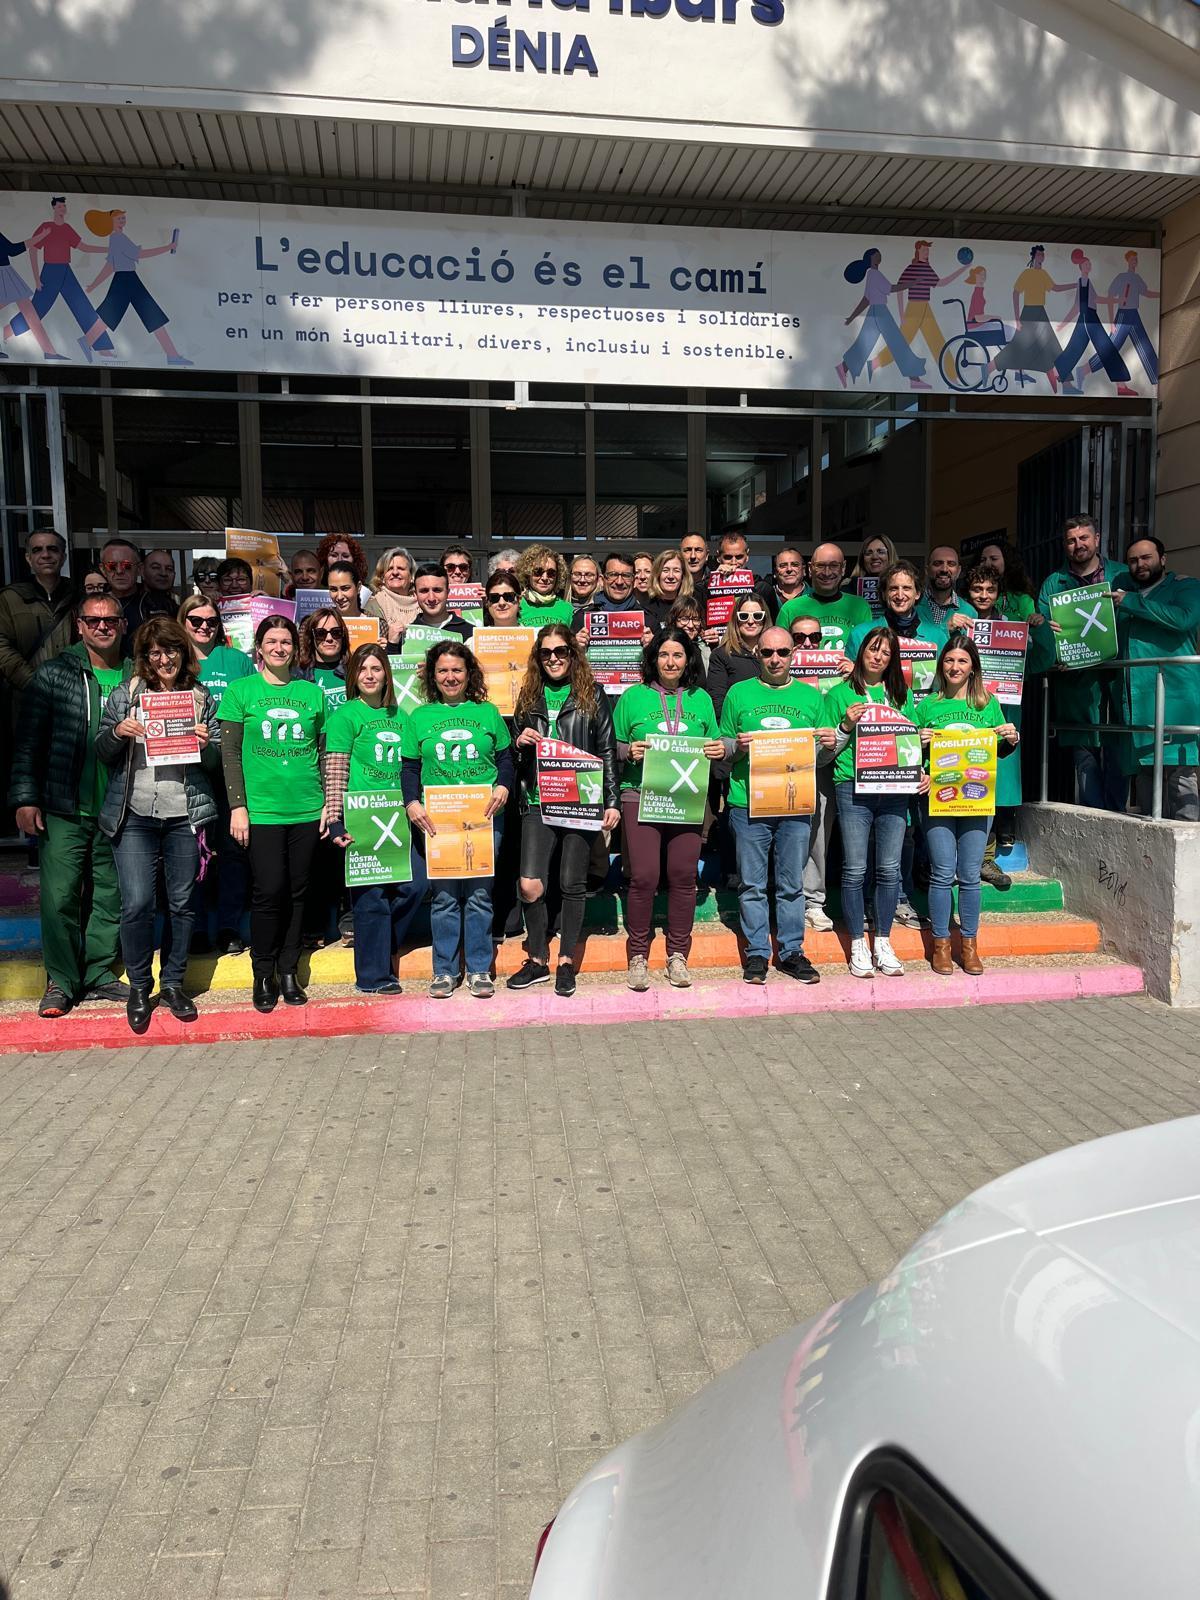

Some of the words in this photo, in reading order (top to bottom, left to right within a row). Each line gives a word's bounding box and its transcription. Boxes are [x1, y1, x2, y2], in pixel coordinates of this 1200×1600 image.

[452, 16, 598, 76] DÉNIA
[255, 236, 514, 284] L'educació
[534, 252, 582, 286] és
[603, 256, 650, 289] el
[670, 262, 767, 294] camí
[218, 291, 253, 306] per
[266, 294, 277, 305] a
[289, 292, 323, 308] fer
[335, 297, 425, 312] persones
[438, 300, 524, 319] lliures,
[537, 306, 665, 323] respectuoses
[677, 309, 686, 324] i
[699, 311, 801, 328] solidàries
[225, 327, 248, 339] en
[261, 329, 283, 340] un
[295, 327, 330, 343] món
[343, 329, 463, 349] igualitari,
[477, 335, 552, 353] divers,
[565, 338, 650, 355] inclusiu
[661, 341, 671, 355] i
[683, 345, 793, 360] sostenible.
[710, 574, 720, 586] 31
[723, 574, 751, 585] MARÇ
[865, 580, 876, 588] 12
[449, 587, 478, 598] MARÇ
[864, 592, 877, 600] 24
[1052, 594, 1071, 607] NO
[593, 615, 606, 623] 12
[612, 620, 640, 629] MARÇ
[976, 623, 989, 631] 12
[405, 629, 425, 640] NO
[592, 627, 607, 635] 24
[995, 630, 1024, 640] MARÇ
[974, 635, 989, 644] 24
[1060, 642, 1086, 651] NOSTRA
[1060, 647, 1090, 657] LLENGUA
[1081, 650, 1101, 659] TOCA!
[806, 653, 841, 665] MARÇ
[143, 696, 152, 707] 7
[258, 697, 307, 710] ESTIMEM
[753, 704, 801, 719] ESTIMEM
[540, 741, 557, 757] 31
[650, 739, 670, 752] NO
[671, 746, 704, 754] CENSURA
[347, 795, 369, 810] NO
[370, 794, 376, 802] A
[644, 794, 673, 802] NOSTRA
[370, 800, 404, 809] CENSURA
[643, 800, 676, 808] LLENGUA
[665, 807, 686, 815] TOCA!
[349, 855, 378, 863] NOSTRA
[349, 861, 381, 870] LLENGUA
[371, 866, 392, 874] TOCA!
